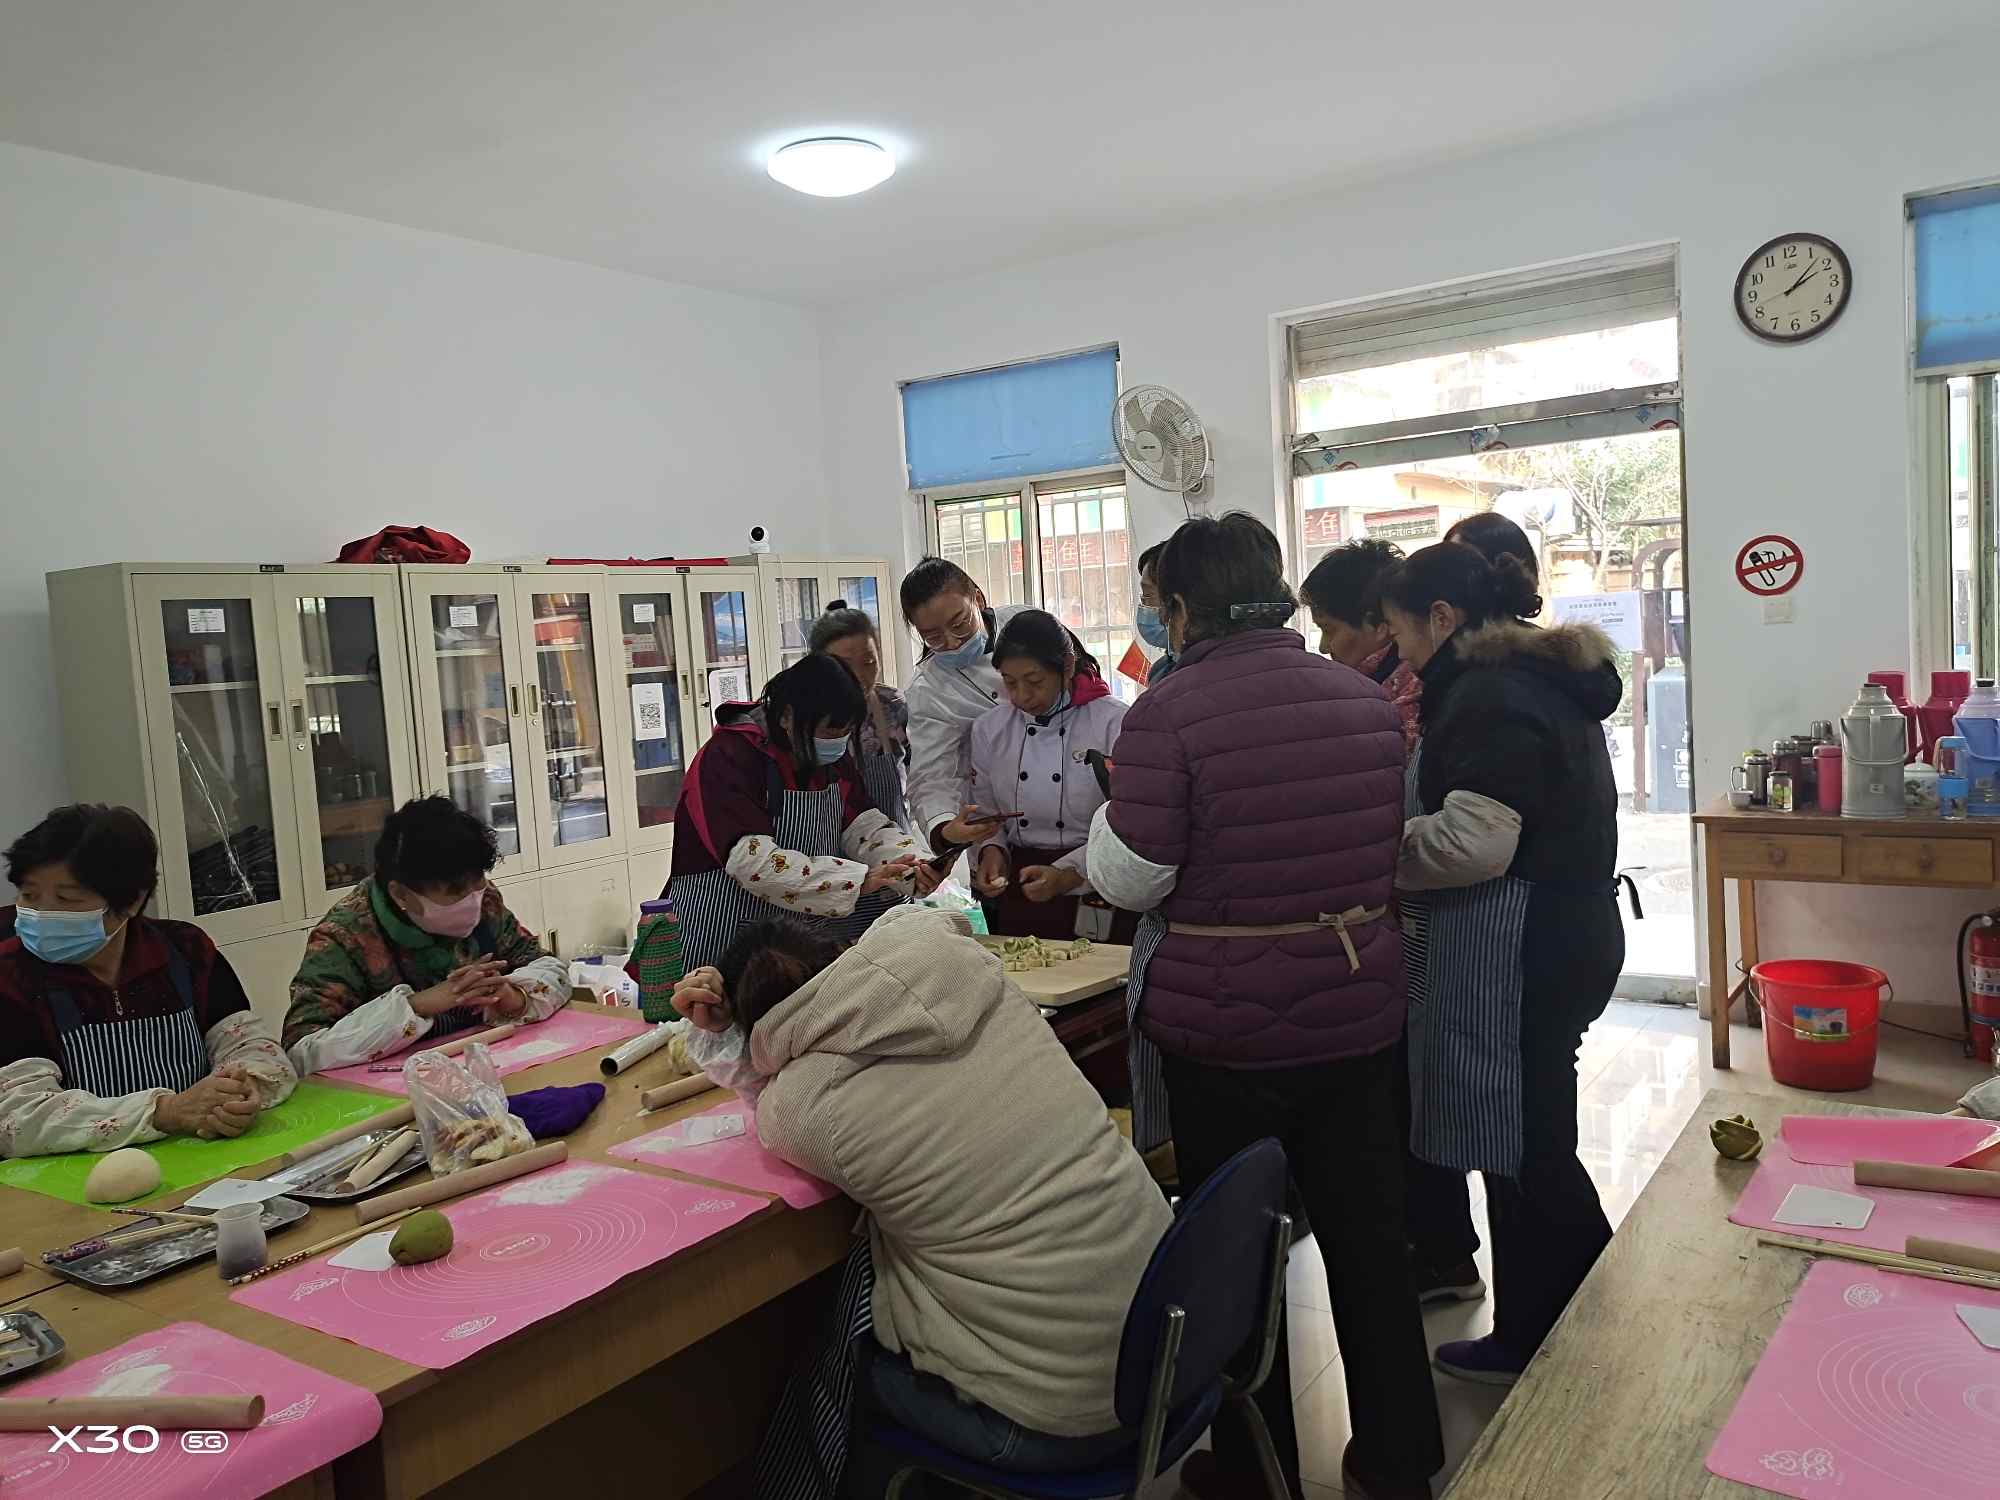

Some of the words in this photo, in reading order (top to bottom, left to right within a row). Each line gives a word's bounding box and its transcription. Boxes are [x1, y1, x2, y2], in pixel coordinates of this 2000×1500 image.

[1783, 245, 1798, 259] 12
[1808, 247, 1814, 259] 1
[1765, 255, 1775, 268] 11
[1822, 257, 1832, 271] 2
[1751, 272, 1763, 286] 10
[1829, 273, 1840, 287] 3
[1748, 290, 1758, 303] 9
[1823, 293, 1833, 305] 4
[1755, 306, 1765, 319] 8
[1809, 309, 1821, 323] 5
[1769, 317, 1779, 330] 7
[1790, 318, 1801, 331] 6
